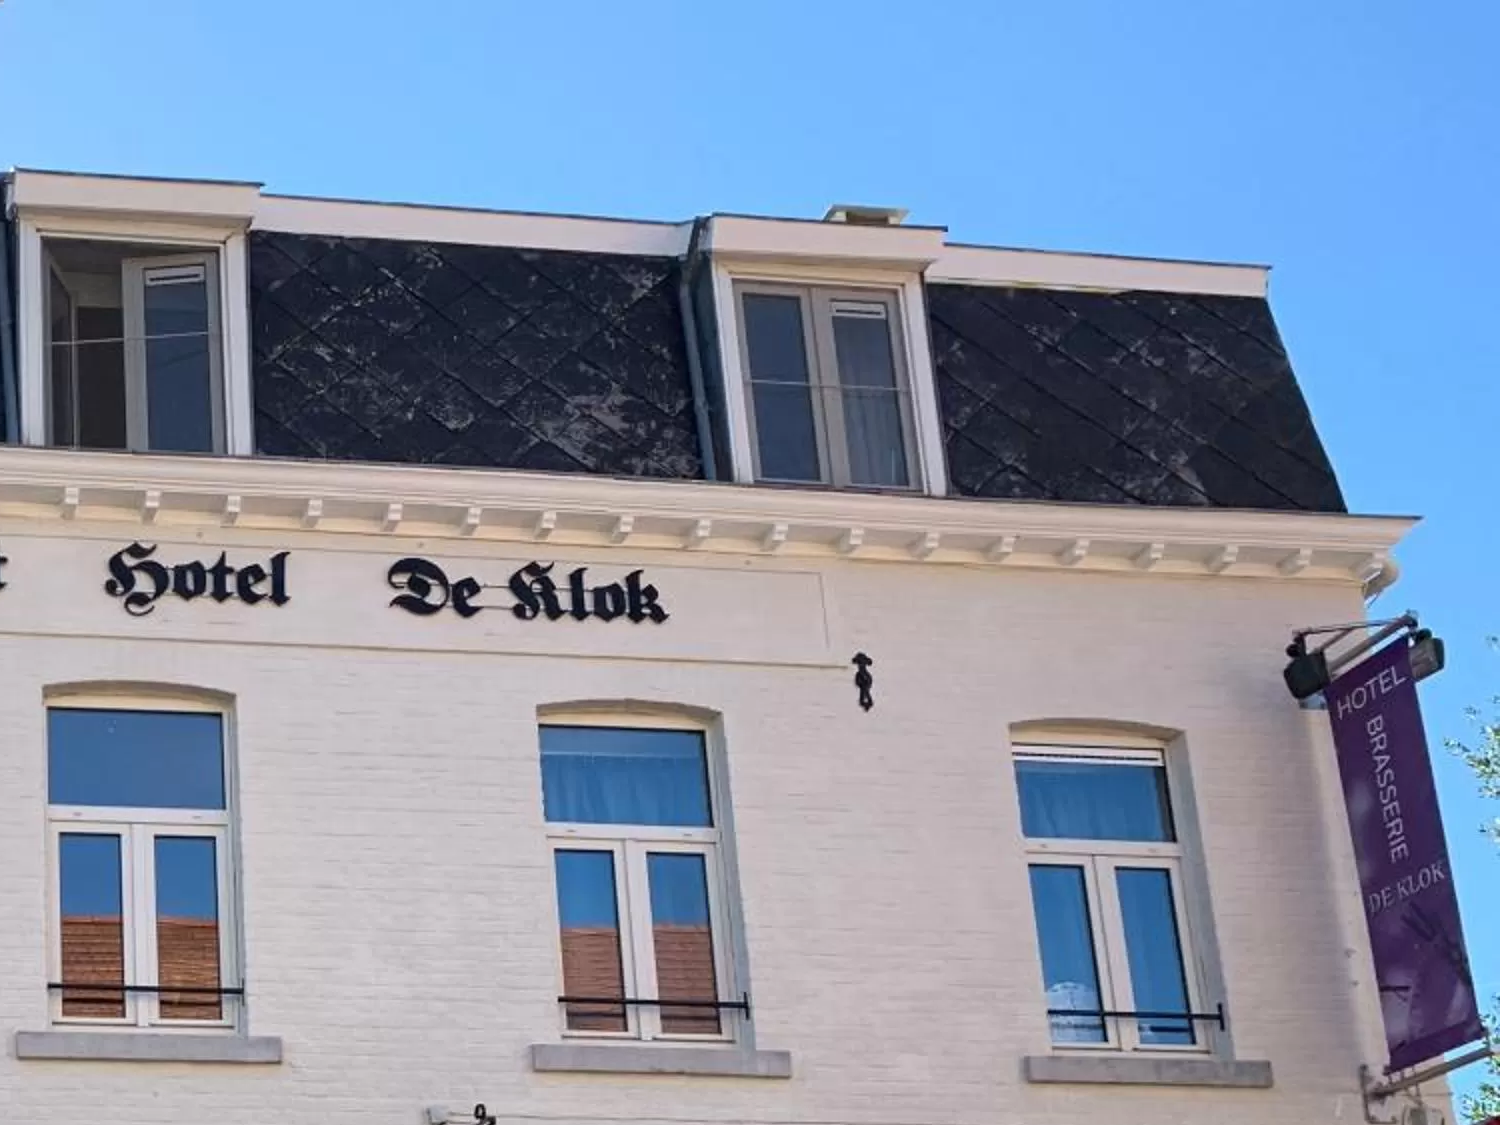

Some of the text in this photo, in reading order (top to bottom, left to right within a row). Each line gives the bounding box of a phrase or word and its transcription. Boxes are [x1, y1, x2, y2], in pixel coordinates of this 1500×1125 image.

[104, 540, 292, 617] Hotel
[387, 557, 484, 618] De
[508, 561, 670, 624] Klok
[1336, 665, 1407, 720] HOTEL
[1366, 714, 1410, 863] BRASSERIE
[1367, 861, 1446, 914] DE KLOK
